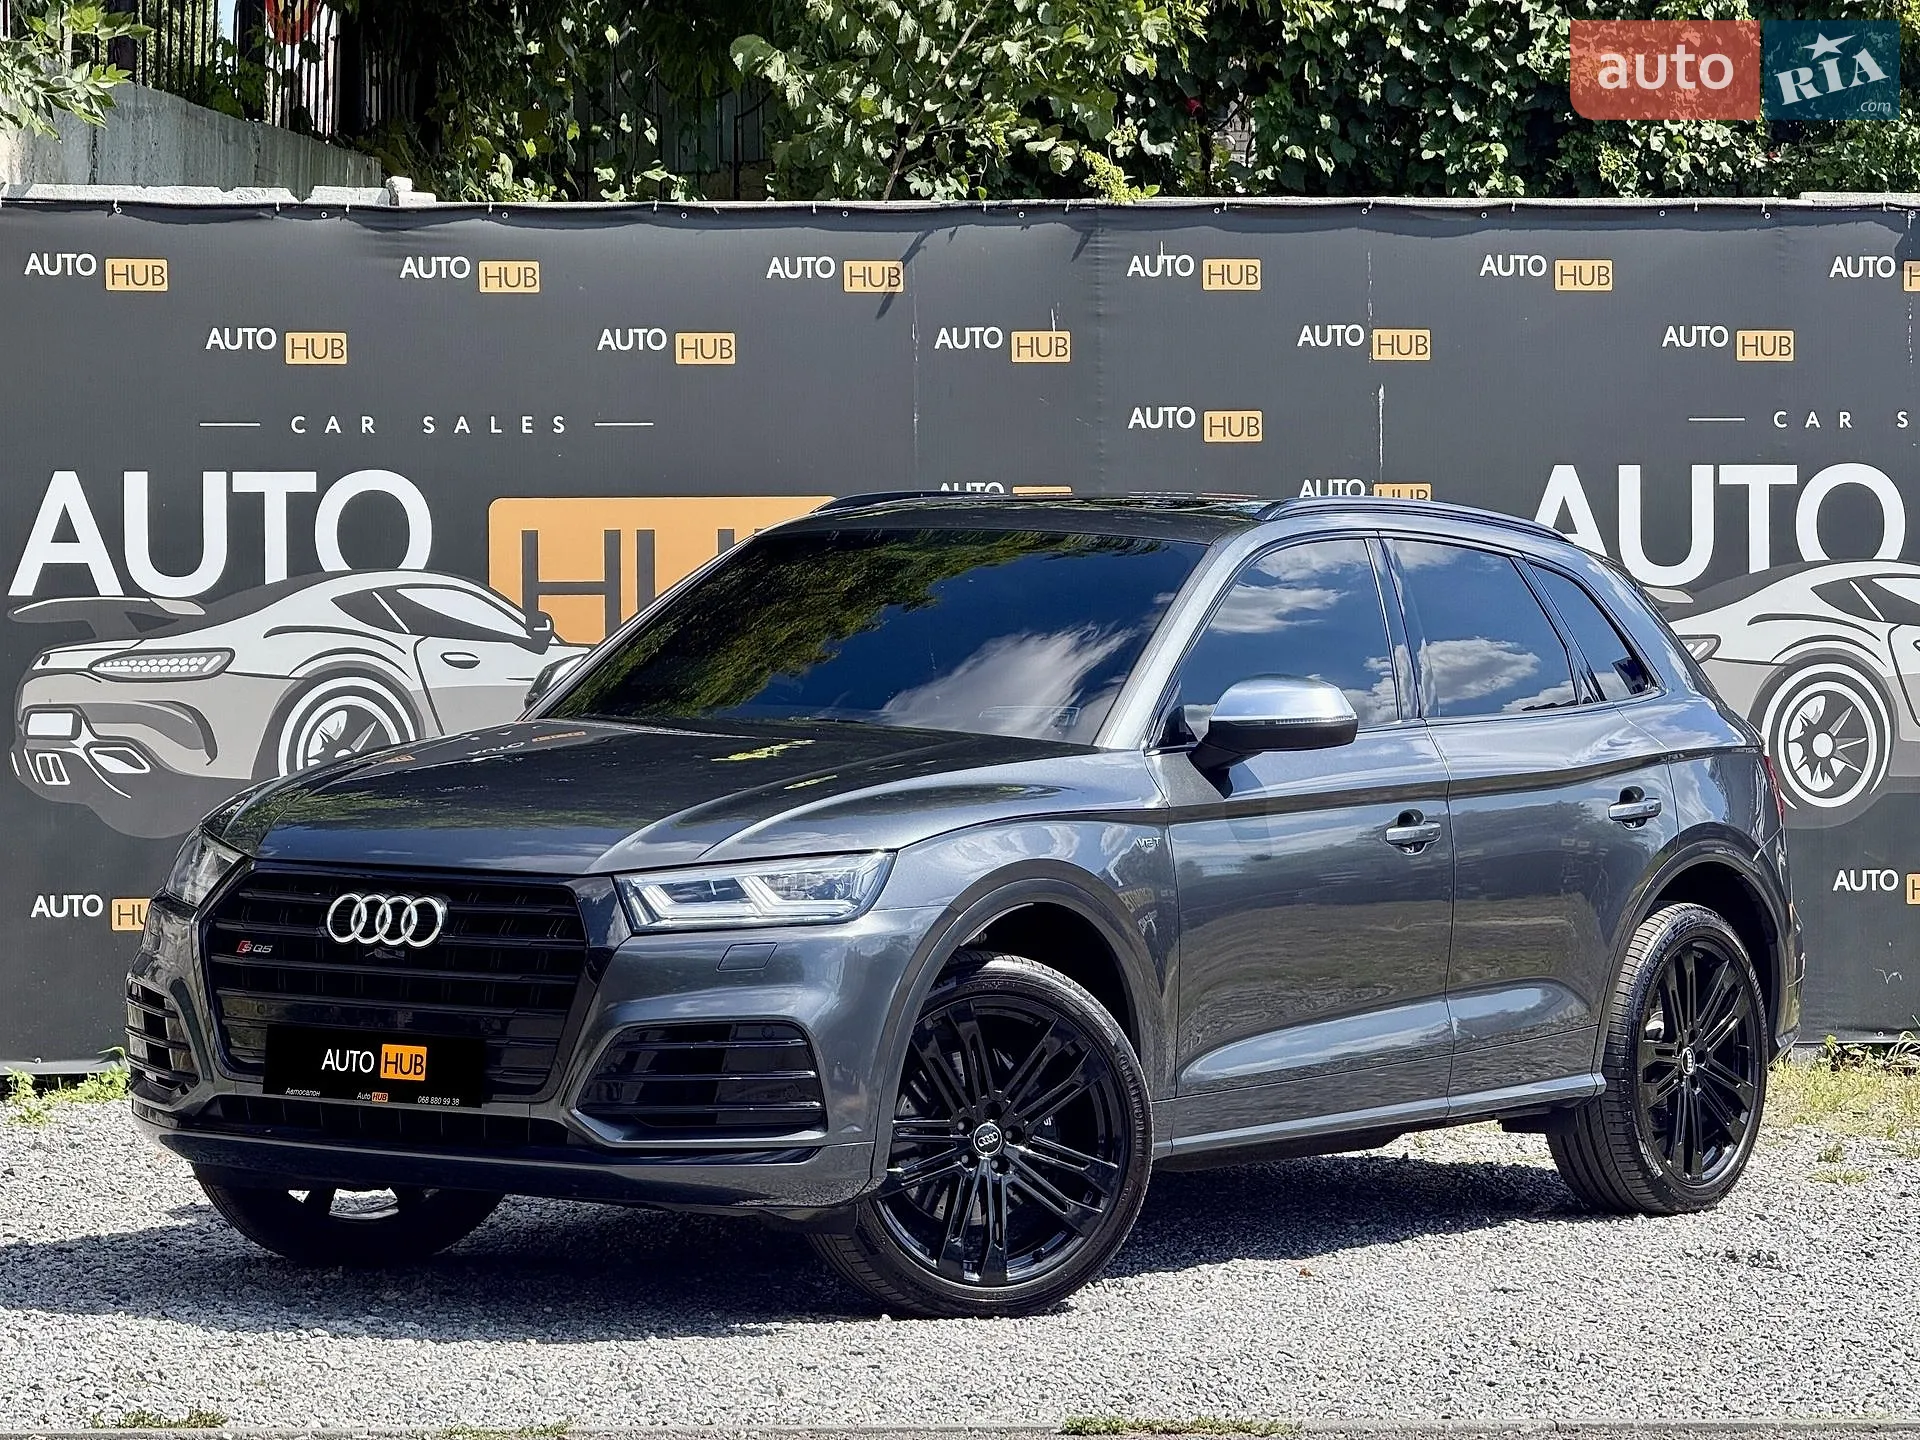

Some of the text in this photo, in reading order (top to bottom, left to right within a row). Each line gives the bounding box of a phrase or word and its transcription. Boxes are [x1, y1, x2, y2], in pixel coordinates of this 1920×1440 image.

[24, 252, 166, 287] AUTO HUB
[399, 256, 538, 289] AUTO HUB
[765, 256, 901, 288] AUTO HUB
[1126, 254, 1259, 286] AUTO HUB
[1479, 254, 1611, 287] AUTO HUB
[1829, 255, 1896, 278] AUTO
[205, 327, 345, 360] AUTO HUB
[597, 327, 734, 360] AUTO HUB
[934, 326, 1068, 358] AUTO HUB
[1297, 324, 1429, 356] AUTO HUB
[1661, 325, 1793, 357] AUTO HUB
[290, 415, 566, 434] CAR SALES
[1128, 406, 1261, 438] AUTO HUB
[1773, 410, 1853, 429] CAR
[8, 470, 433, 598] AUTO
[1534, 462, 1906, 587] AUTO
[1832, 869, 1899, 892] AUTO
[30, 894, 104, 918] AUTO
[321, 1048, 425, 1076] AUTO HUB
[356, 1091, 388, 1101] Auto HUB
[417, 1095, 430, 1104] 068
[442, 1097, 451, 1106] 99
[451, 1098, 460, 1106] 38
